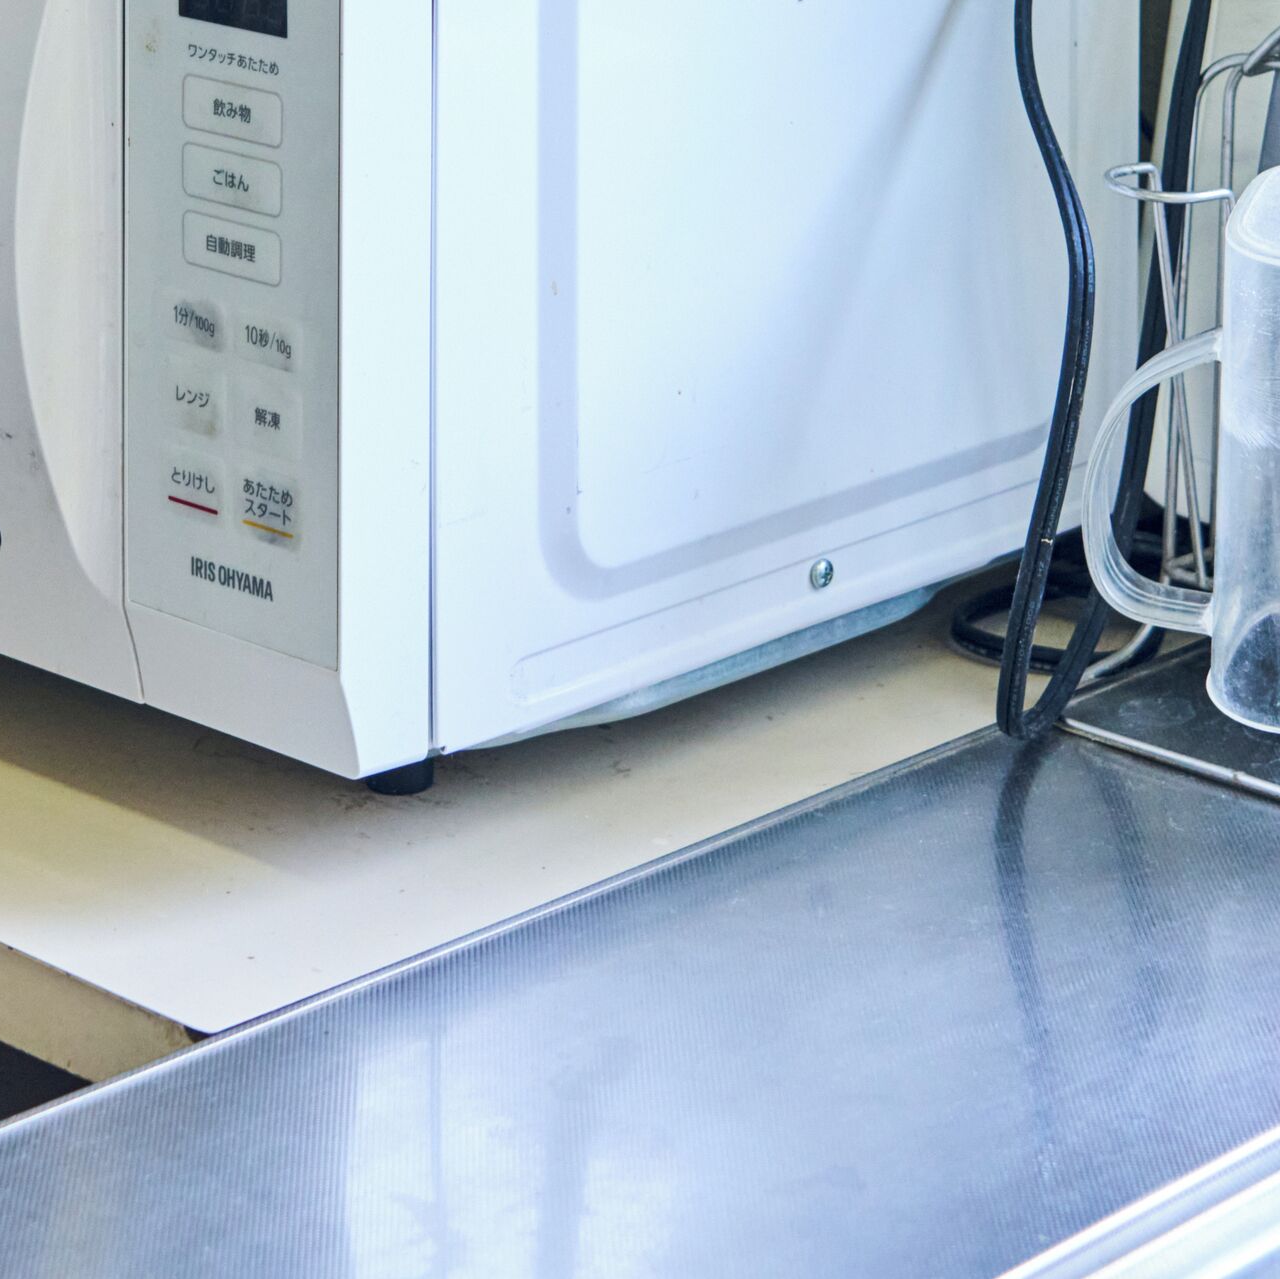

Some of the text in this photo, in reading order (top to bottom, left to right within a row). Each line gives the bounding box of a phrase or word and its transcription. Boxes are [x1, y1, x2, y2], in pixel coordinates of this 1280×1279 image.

[187, 43, 280, 76] ワンタッチあたため
[213, 98, 251, 124] 飲み物
[213, 169, 249, 193] ごはん
[205, 234, 256, 263] 自動調理
[173, 305, 215, 337] 1分/100g
[244, 325, 292, 358] 10秒/10g
[175, 385, 210, 408] レンジ
[254, 407, 281, 431] 解凍
[171, 467, 216, 493] とりけし
[243, 478, 293, 507] あたため
[244, 499, 291, 526] スタート
[191, 556, 273, 602] IRIS OHYAMA
